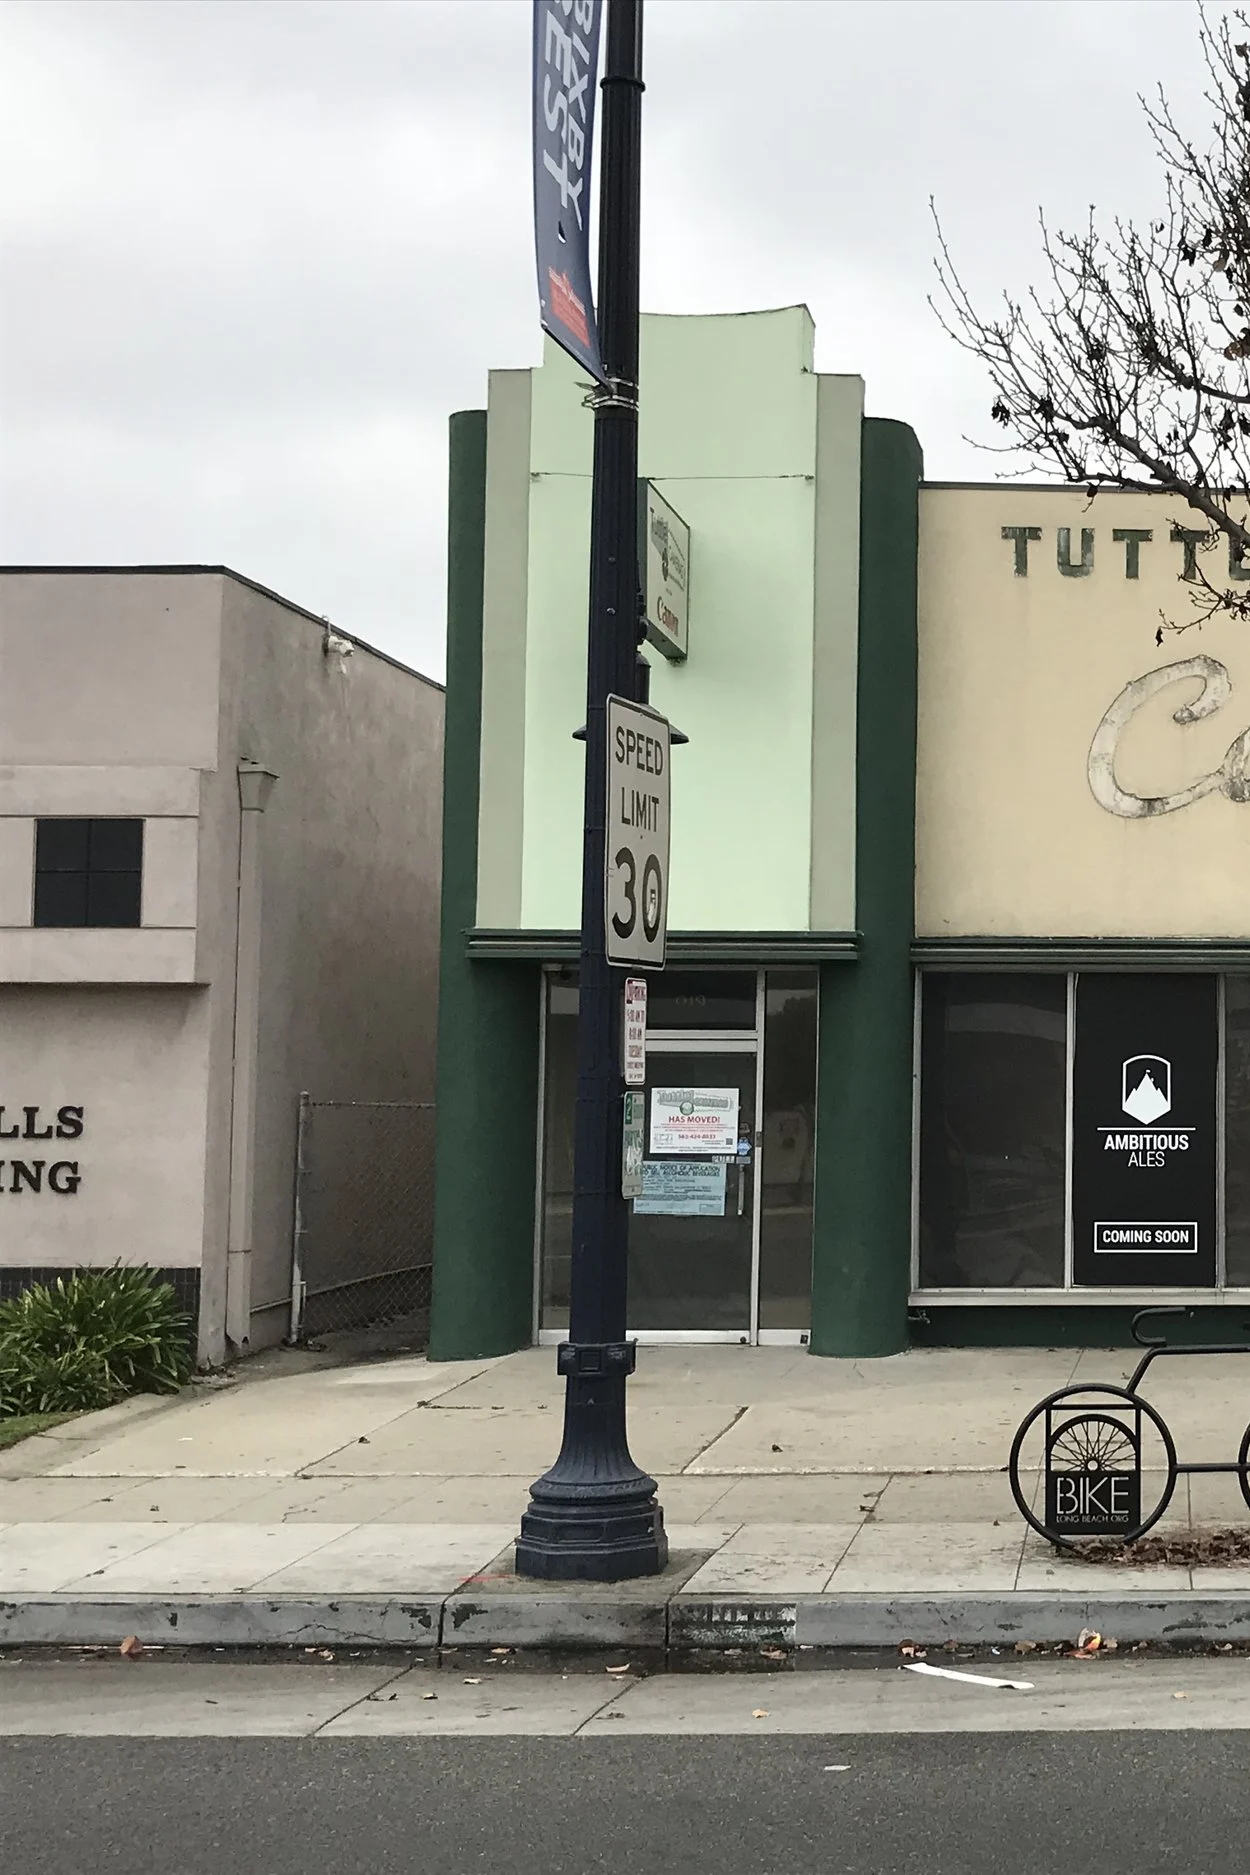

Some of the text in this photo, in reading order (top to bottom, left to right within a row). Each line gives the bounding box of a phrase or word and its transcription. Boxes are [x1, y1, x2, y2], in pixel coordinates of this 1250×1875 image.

[543, 0, 573, 208] EST
[615, 725, 663, 776] SPEED
[621, 786, 660, 832] LIMIT
[612, 846, 662, 943] 30
[0, 1105, 84, 1139] LLS
[668, 1115, 720, 1124] HAS MOVED!
[1103, 1134, 1190, 1151] AMBITIOUS
[1127, 1151, 1165, 1167] ALES
[1102, 1229, 1189, 1243] COMING SOON
[1056, 1476, 1129, 1515] BIKE
[1056, 1515, 1080, 1523] LONG
